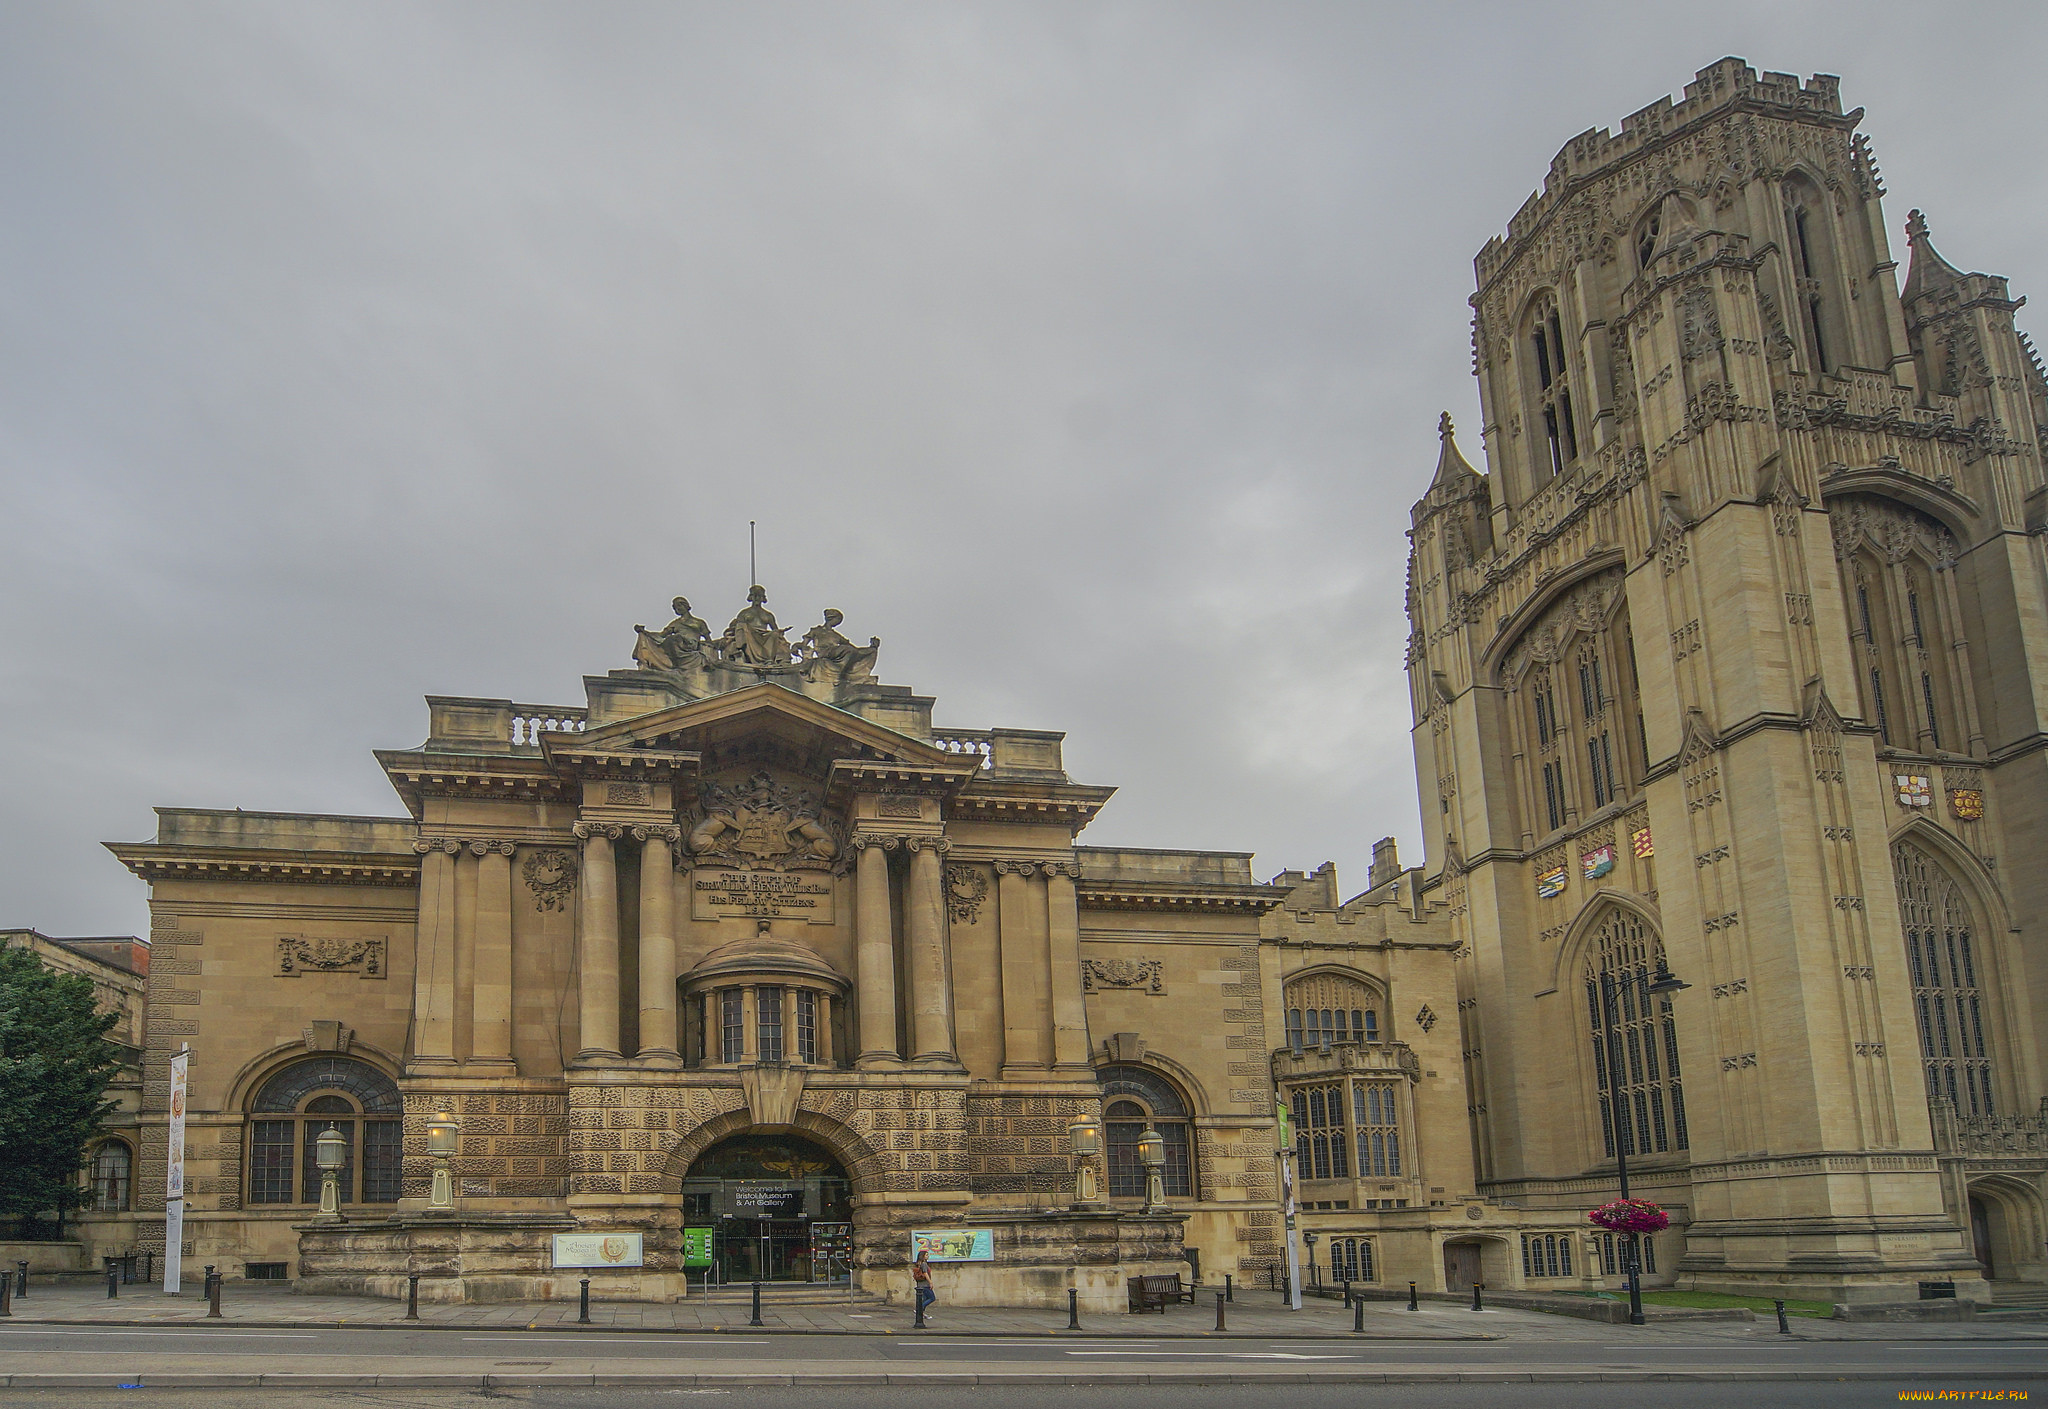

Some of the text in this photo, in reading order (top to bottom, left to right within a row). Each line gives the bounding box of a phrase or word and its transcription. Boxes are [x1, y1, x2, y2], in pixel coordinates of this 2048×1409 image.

[720, 873, 801, 884] THE GIFT OF
[752, 882, 784, 893] HENRY
[709, 896, 727, 904] HIS
[729, 896, 769, 906] FELLOW
[917, 1238, 944, 1251] 25
